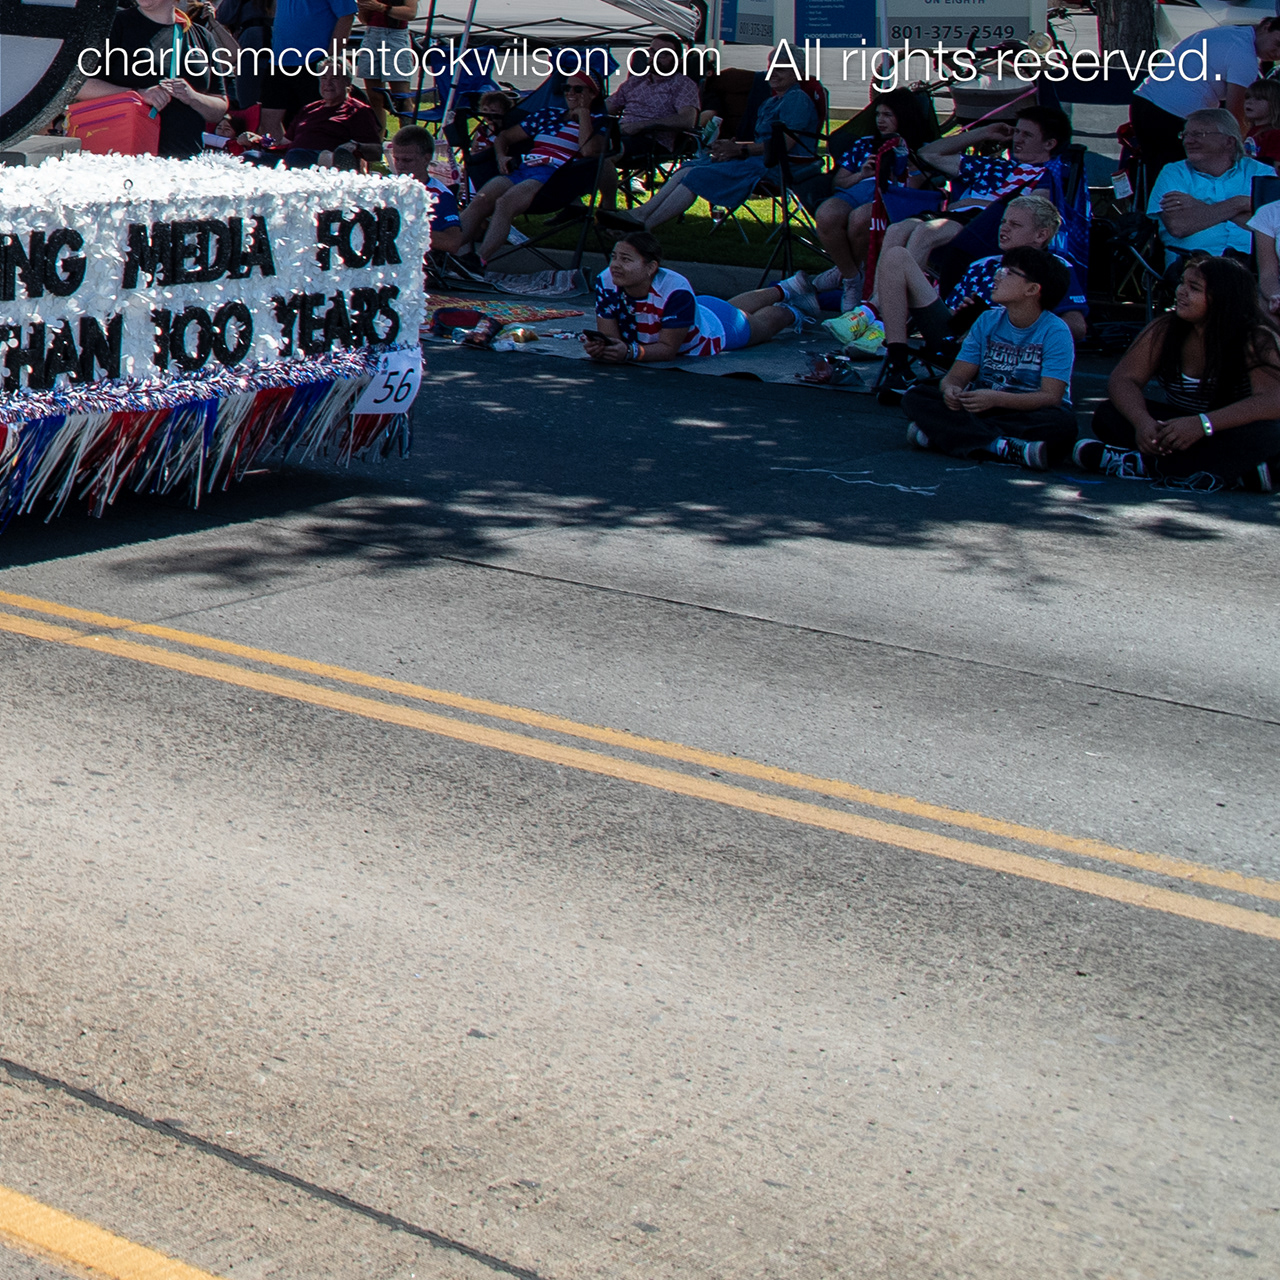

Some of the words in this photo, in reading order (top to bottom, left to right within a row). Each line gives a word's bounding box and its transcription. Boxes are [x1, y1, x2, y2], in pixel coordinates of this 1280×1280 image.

[890, 25, 1015, 40] 801-375-2549
[122, 216, 276, 290] MEDIA
[314, 206, 403, 270] FOR
[152, 300, 256, 372] 100
[272, 284, 401, 357] YEARS
[373, 367, 415, 404] 56
